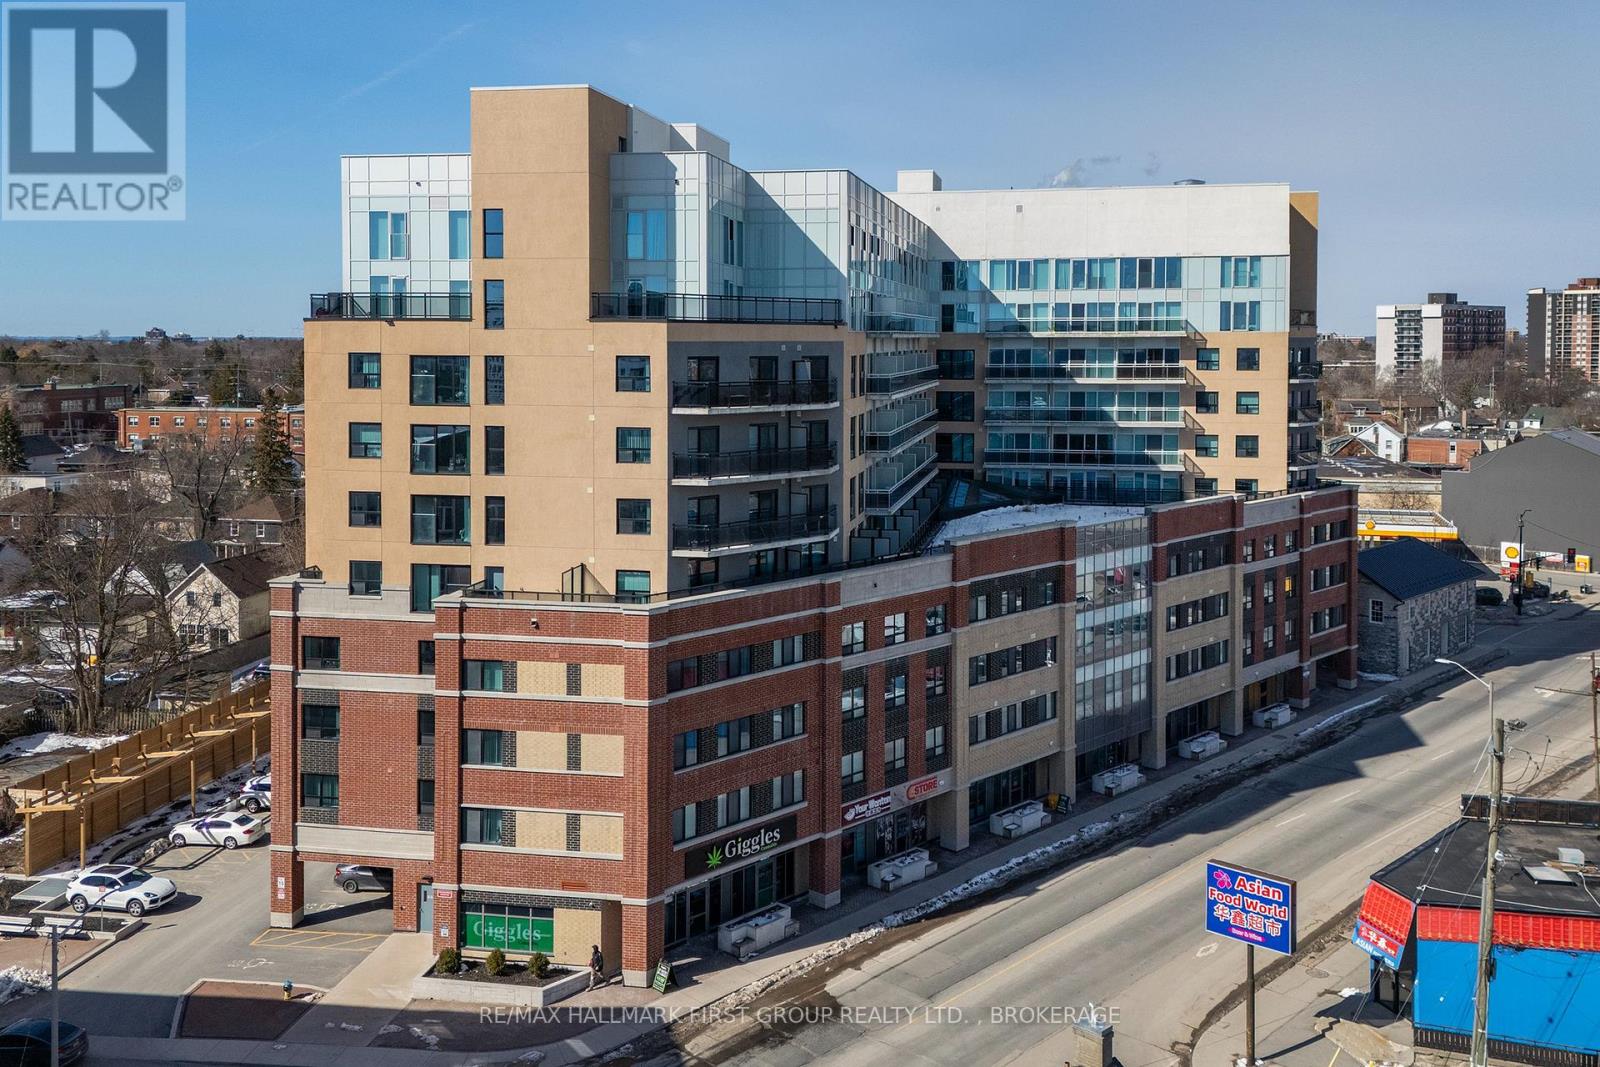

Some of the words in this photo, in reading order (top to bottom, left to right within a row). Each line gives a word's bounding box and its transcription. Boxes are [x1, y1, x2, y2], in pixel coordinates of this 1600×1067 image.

[914, 780, 937, 795] STORE
[725, 828, 781, 858] Giggles
[1234, 876, 1283, 902] Asian
[1208, 886, 1242, 908] Food
[1243, 896, 1288, 921] World
[473, 920, 541, 942] Giggles
[1213, 903, 1282, 936] 华鑫超市
